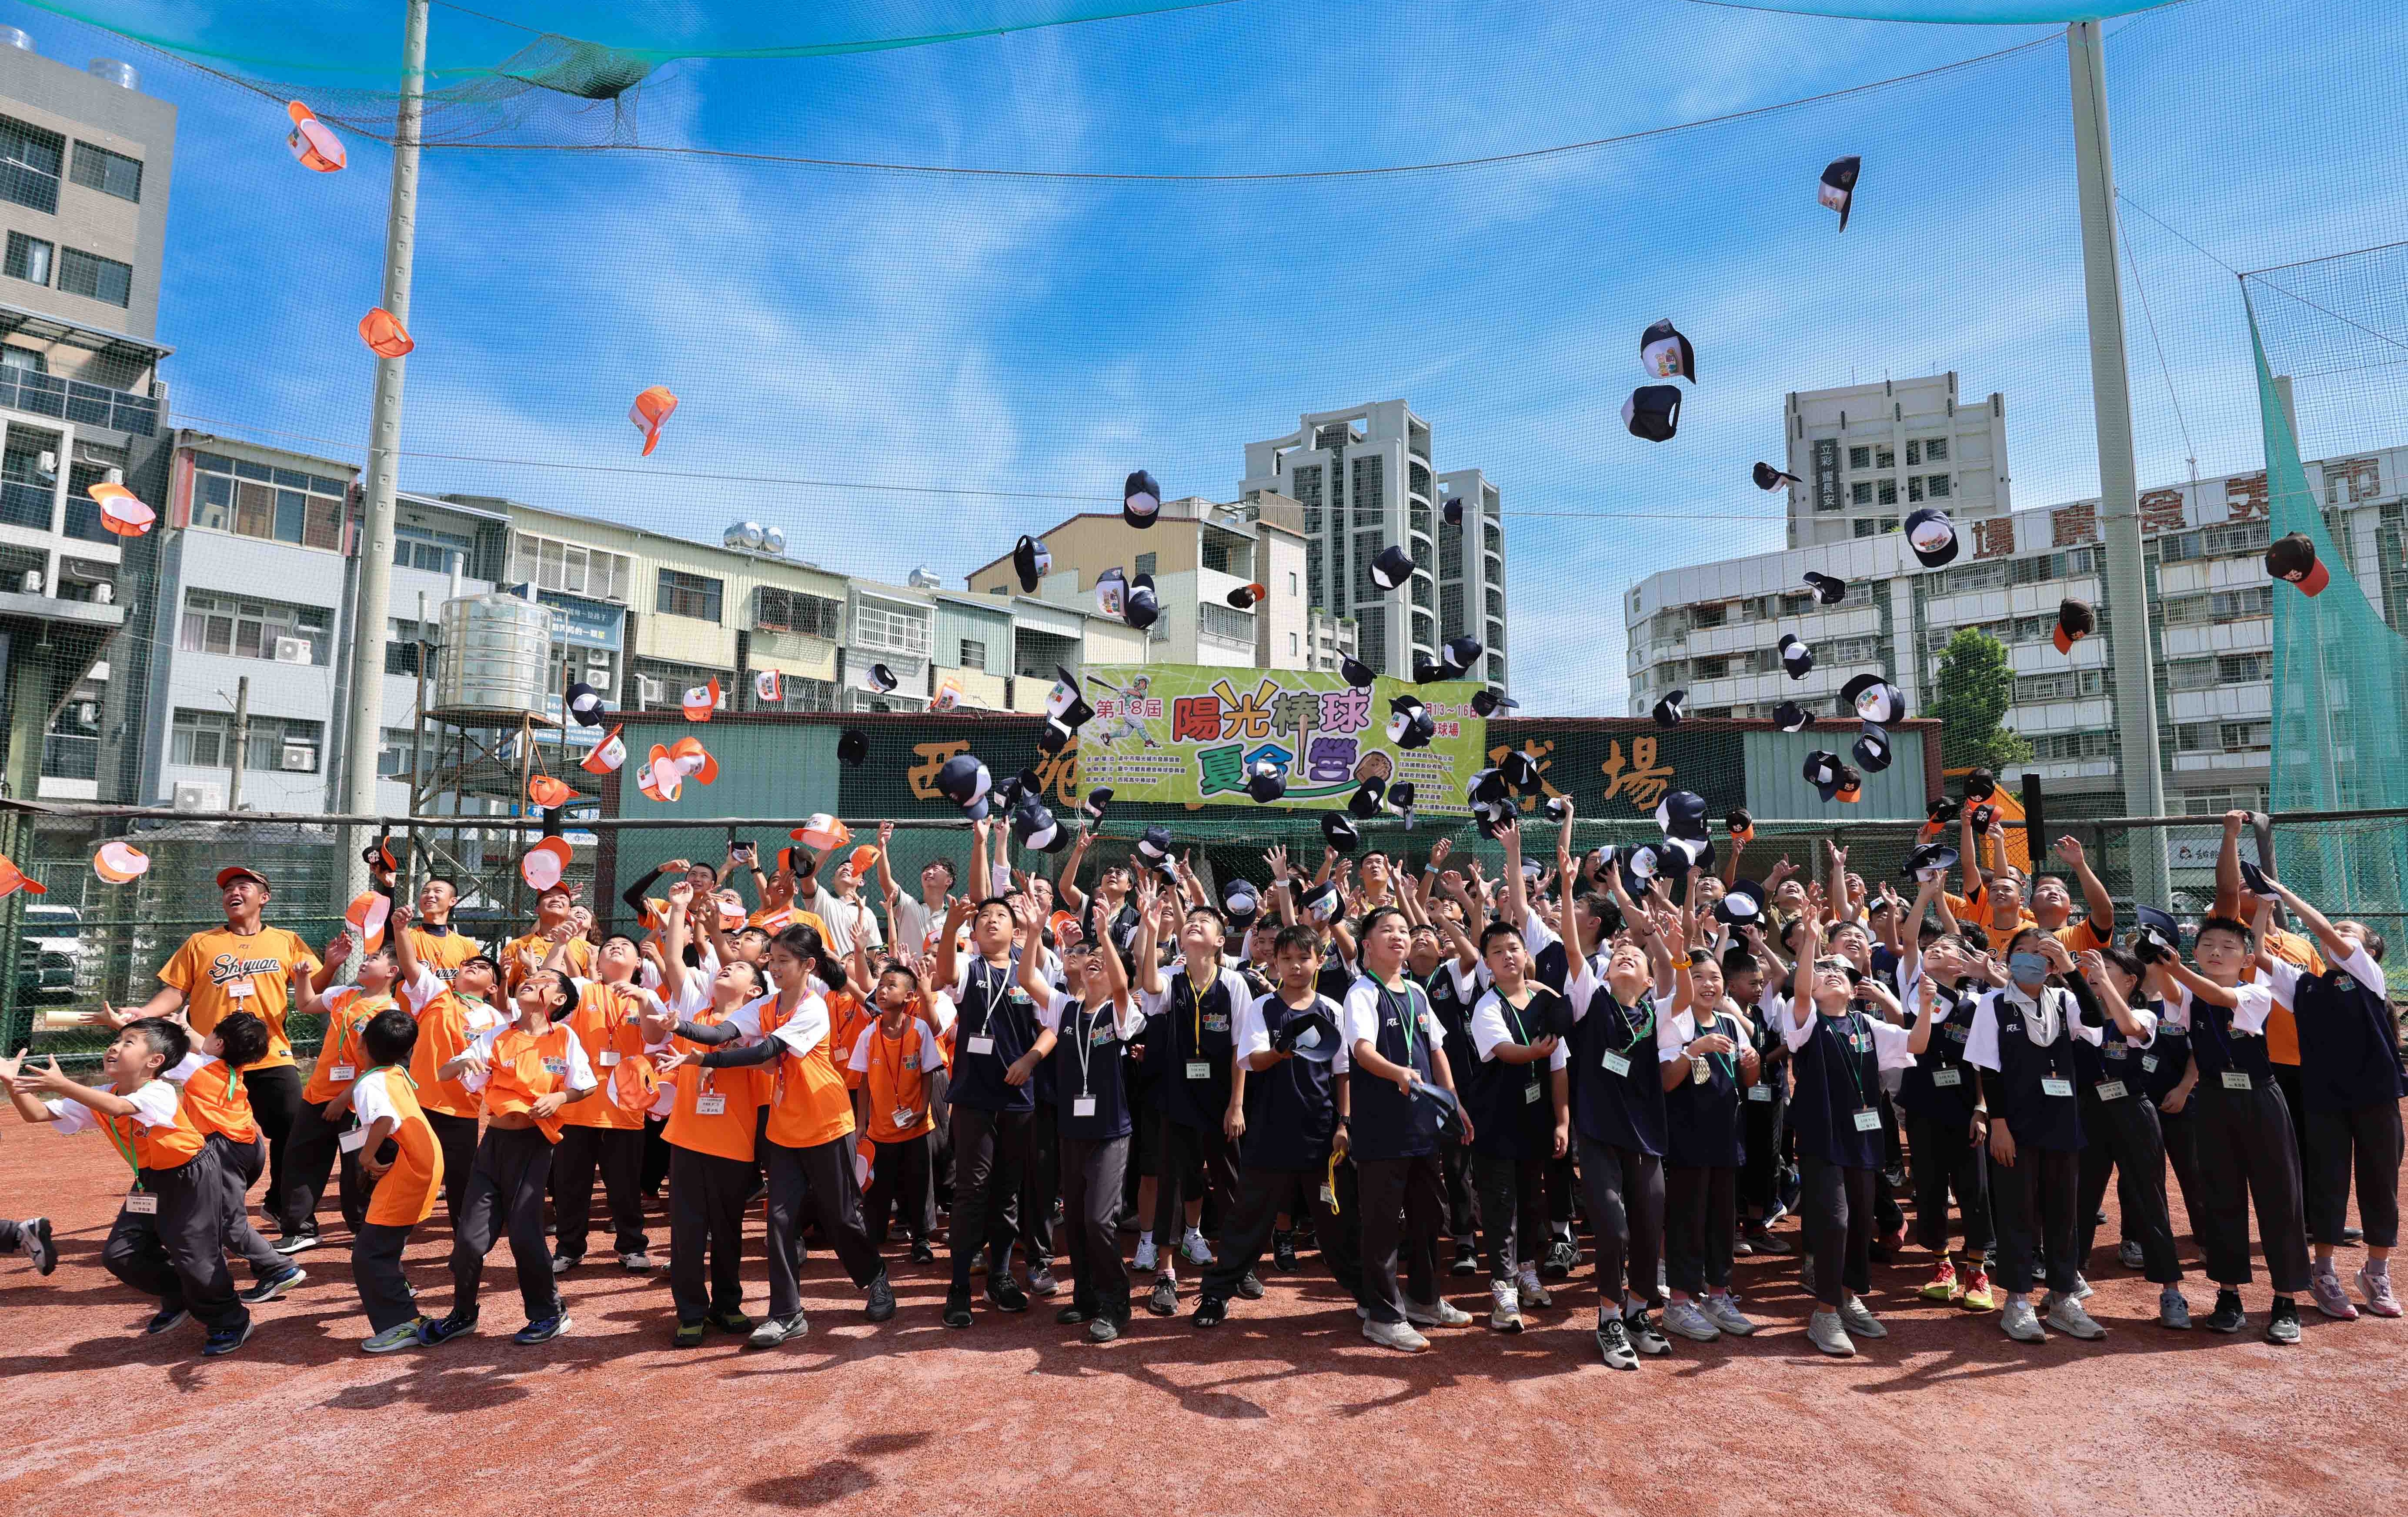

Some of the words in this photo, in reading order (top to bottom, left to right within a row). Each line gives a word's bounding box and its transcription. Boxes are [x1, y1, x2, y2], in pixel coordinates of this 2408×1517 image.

[1096, 699, 1162, 719] 第18屆
[1172, 680, 1369, 742] 陽光棒球
